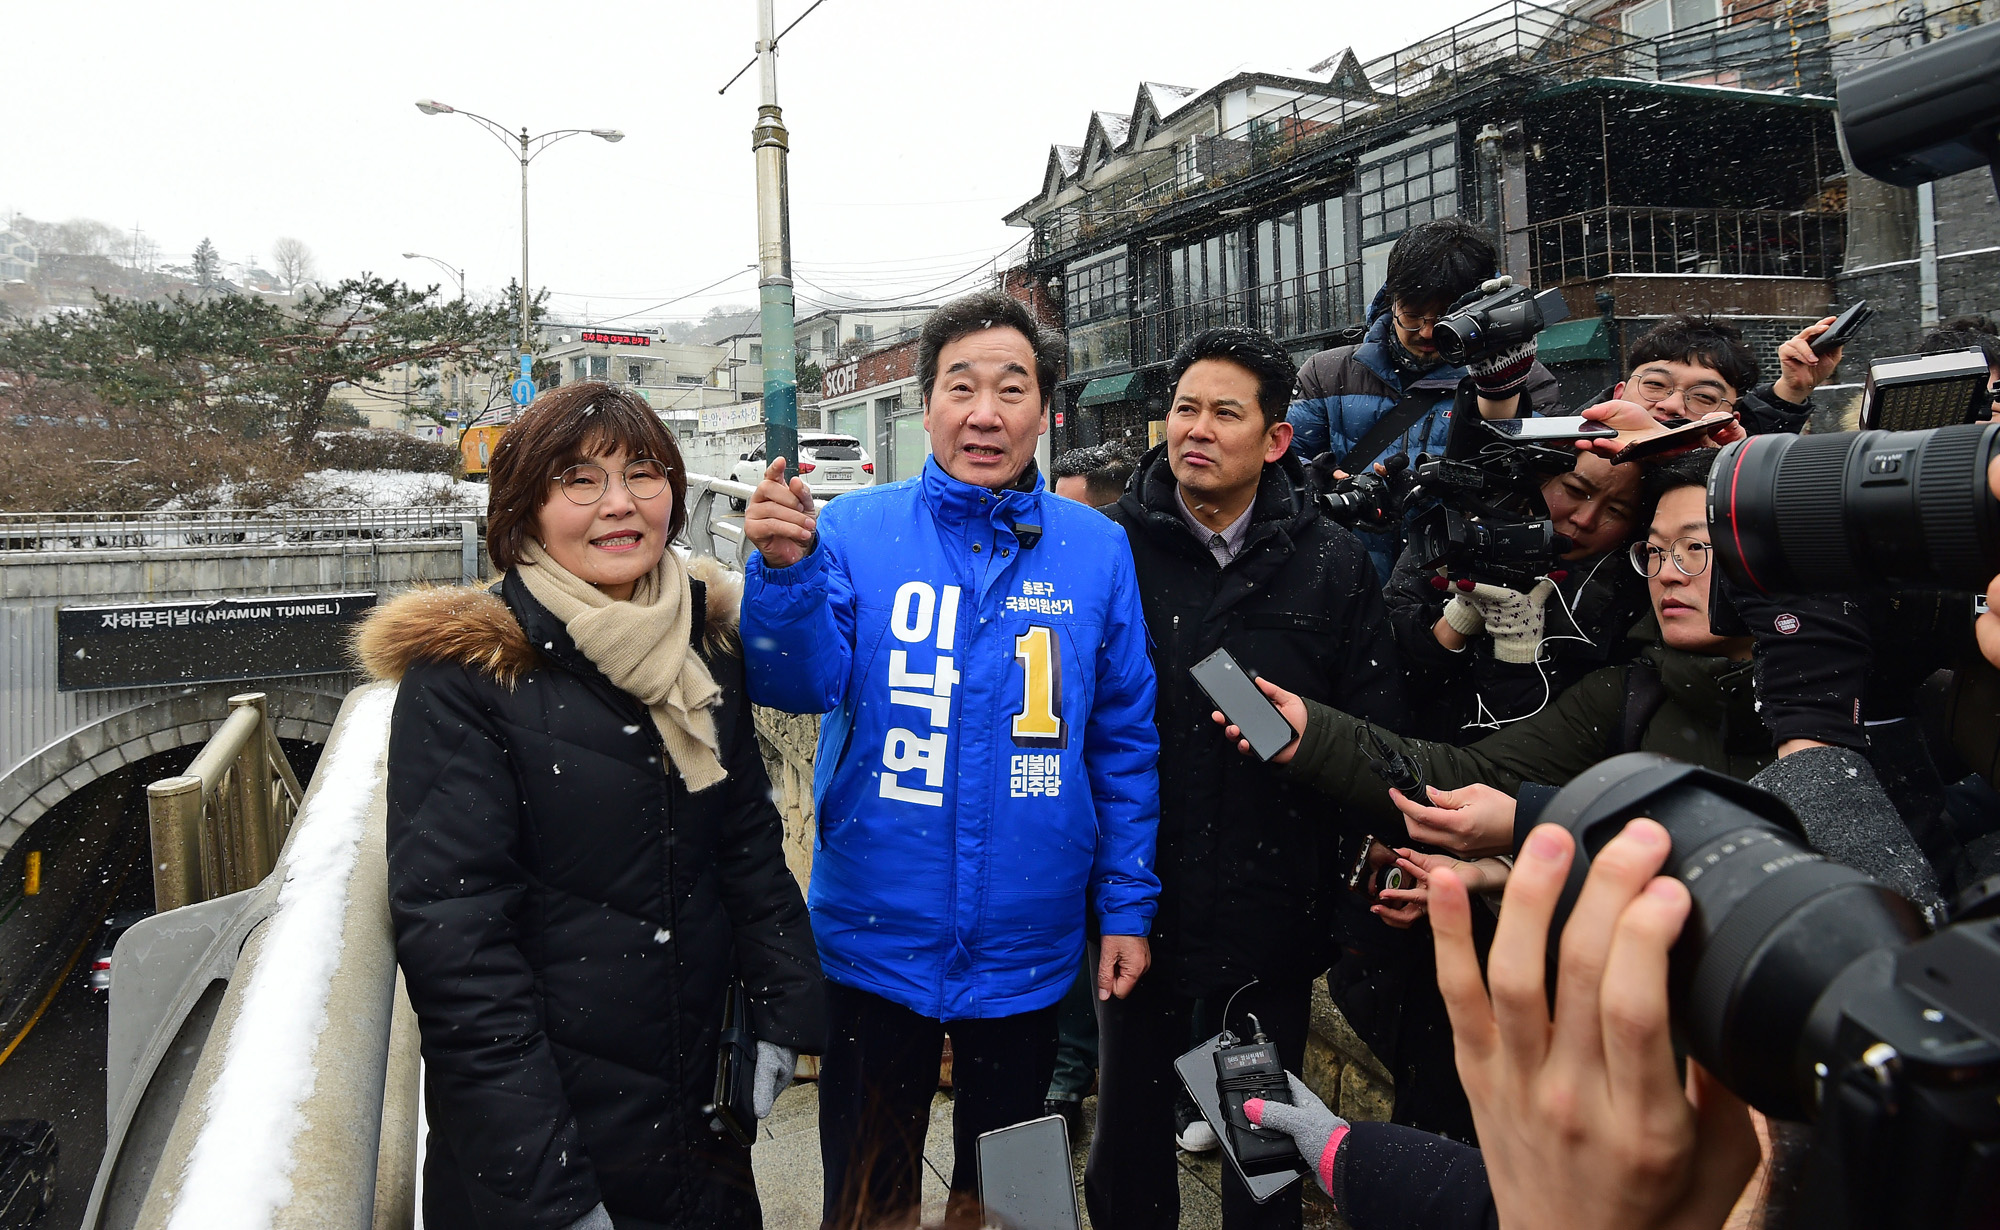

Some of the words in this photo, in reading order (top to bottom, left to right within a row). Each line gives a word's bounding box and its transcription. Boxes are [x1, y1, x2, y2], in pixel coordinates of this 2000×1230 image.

[826, 363, 859, 397] SCOFF
[1022, 580, 1055, 598] 종로구
[276, 602, 341, 618] TUNNEL)
[1005, 596, 1074, 615] 국회의원선거
[879, 581, 961, 807] 이낙연
[1011, 624, 1067, 747] 1
[1010, 754, 1061, 776] 더불어
[1010, 775, 1062, 798] 민주당
